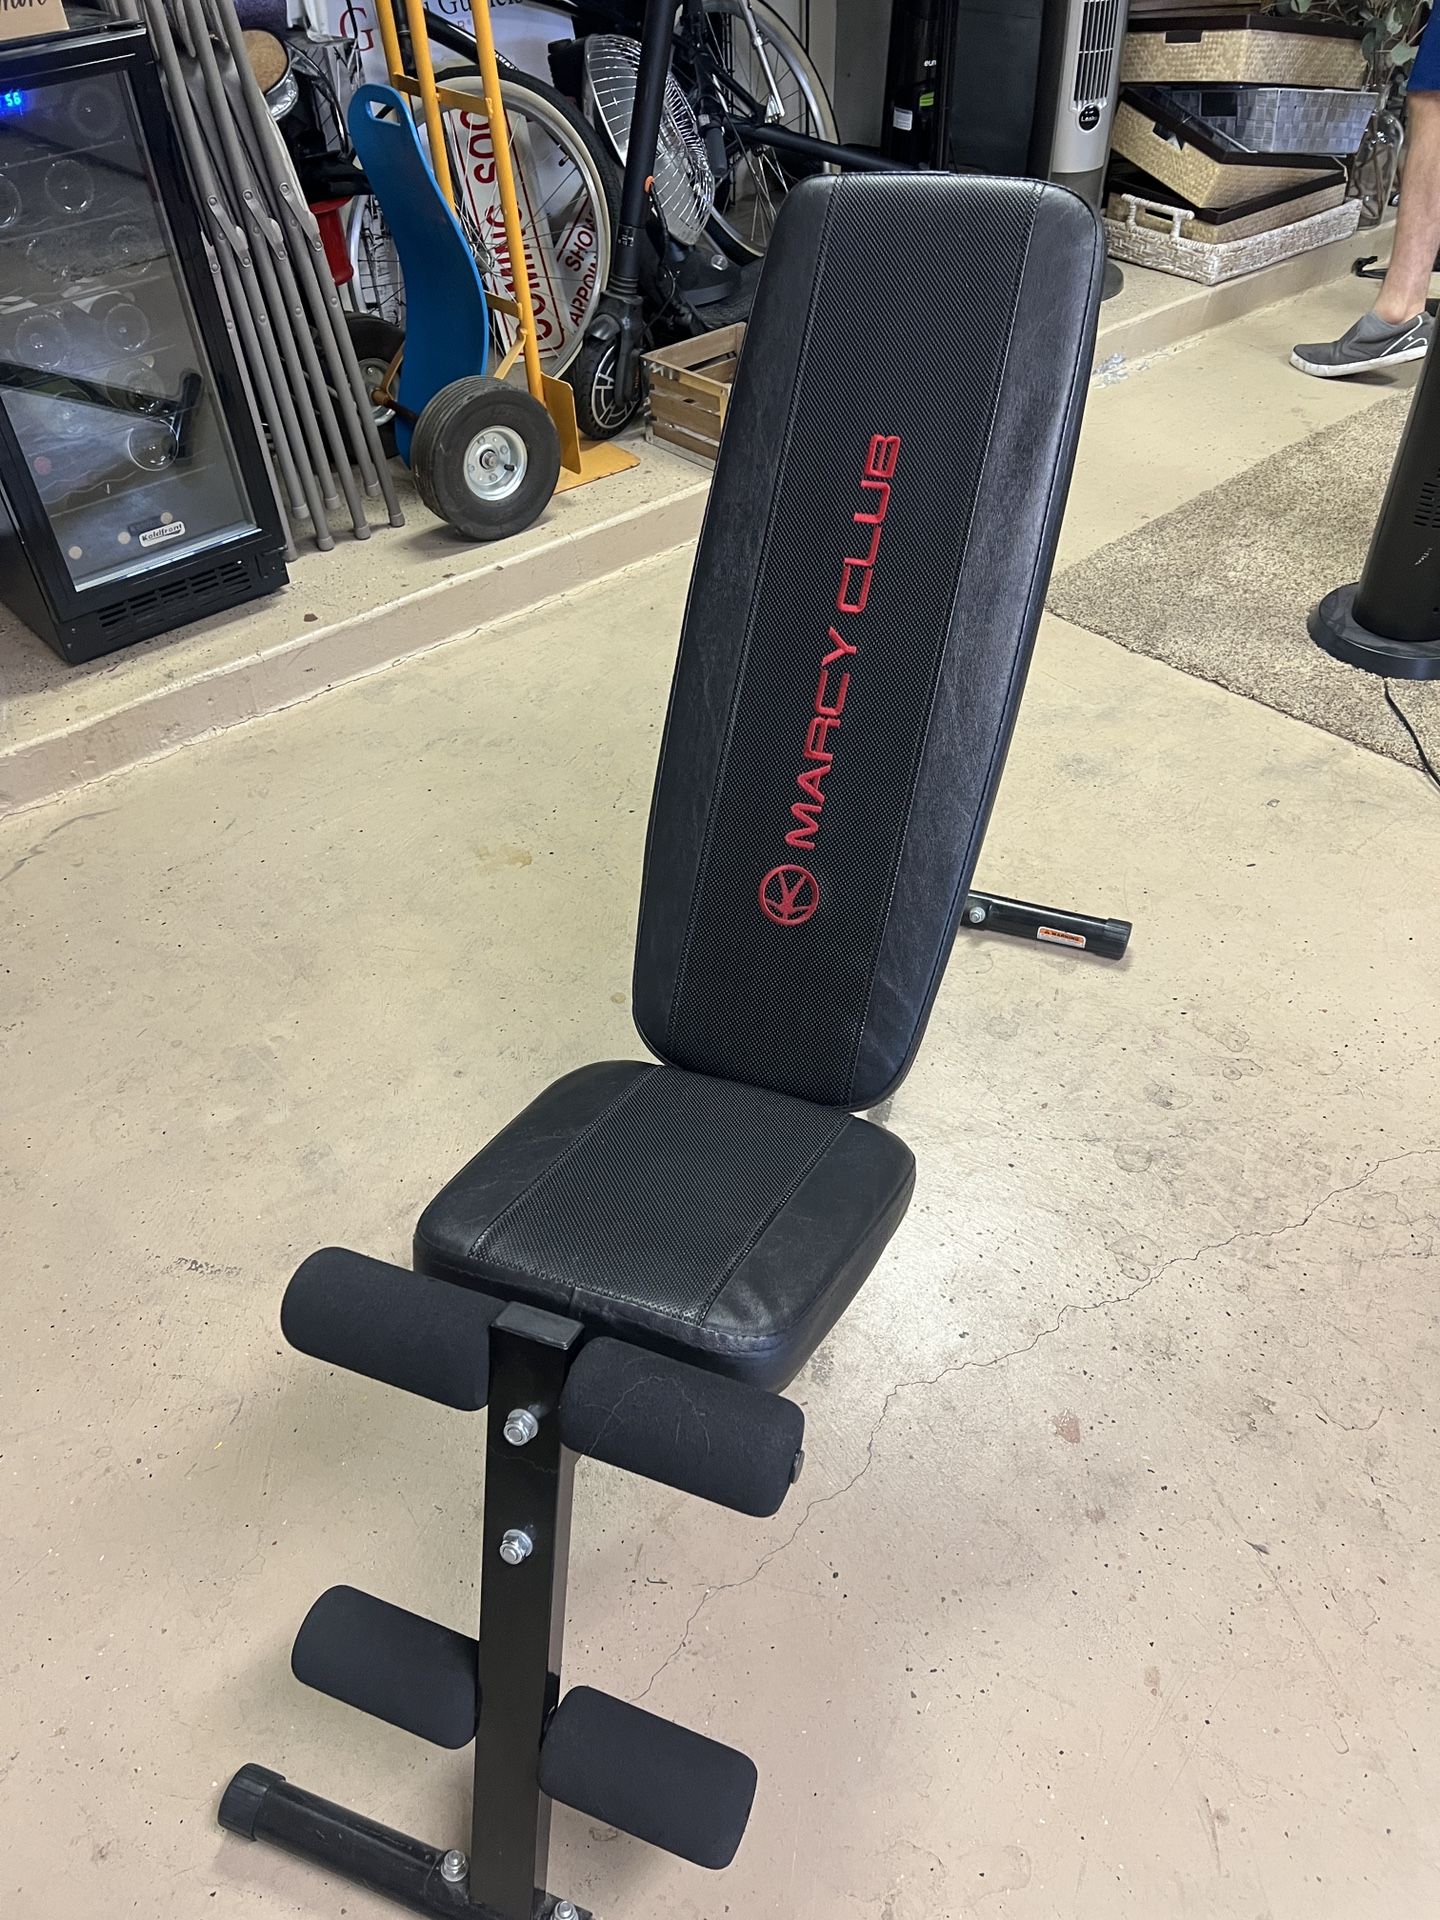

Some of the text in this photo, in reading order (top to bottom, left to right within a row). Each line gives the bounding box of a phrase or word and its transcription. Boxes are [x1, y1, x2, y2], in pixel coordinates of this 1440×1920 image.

[5, 91, 21, 107] 56
[141, 523, 182, 541] Koldfront
[784, 433, 901, 849] MARCY CLUB
